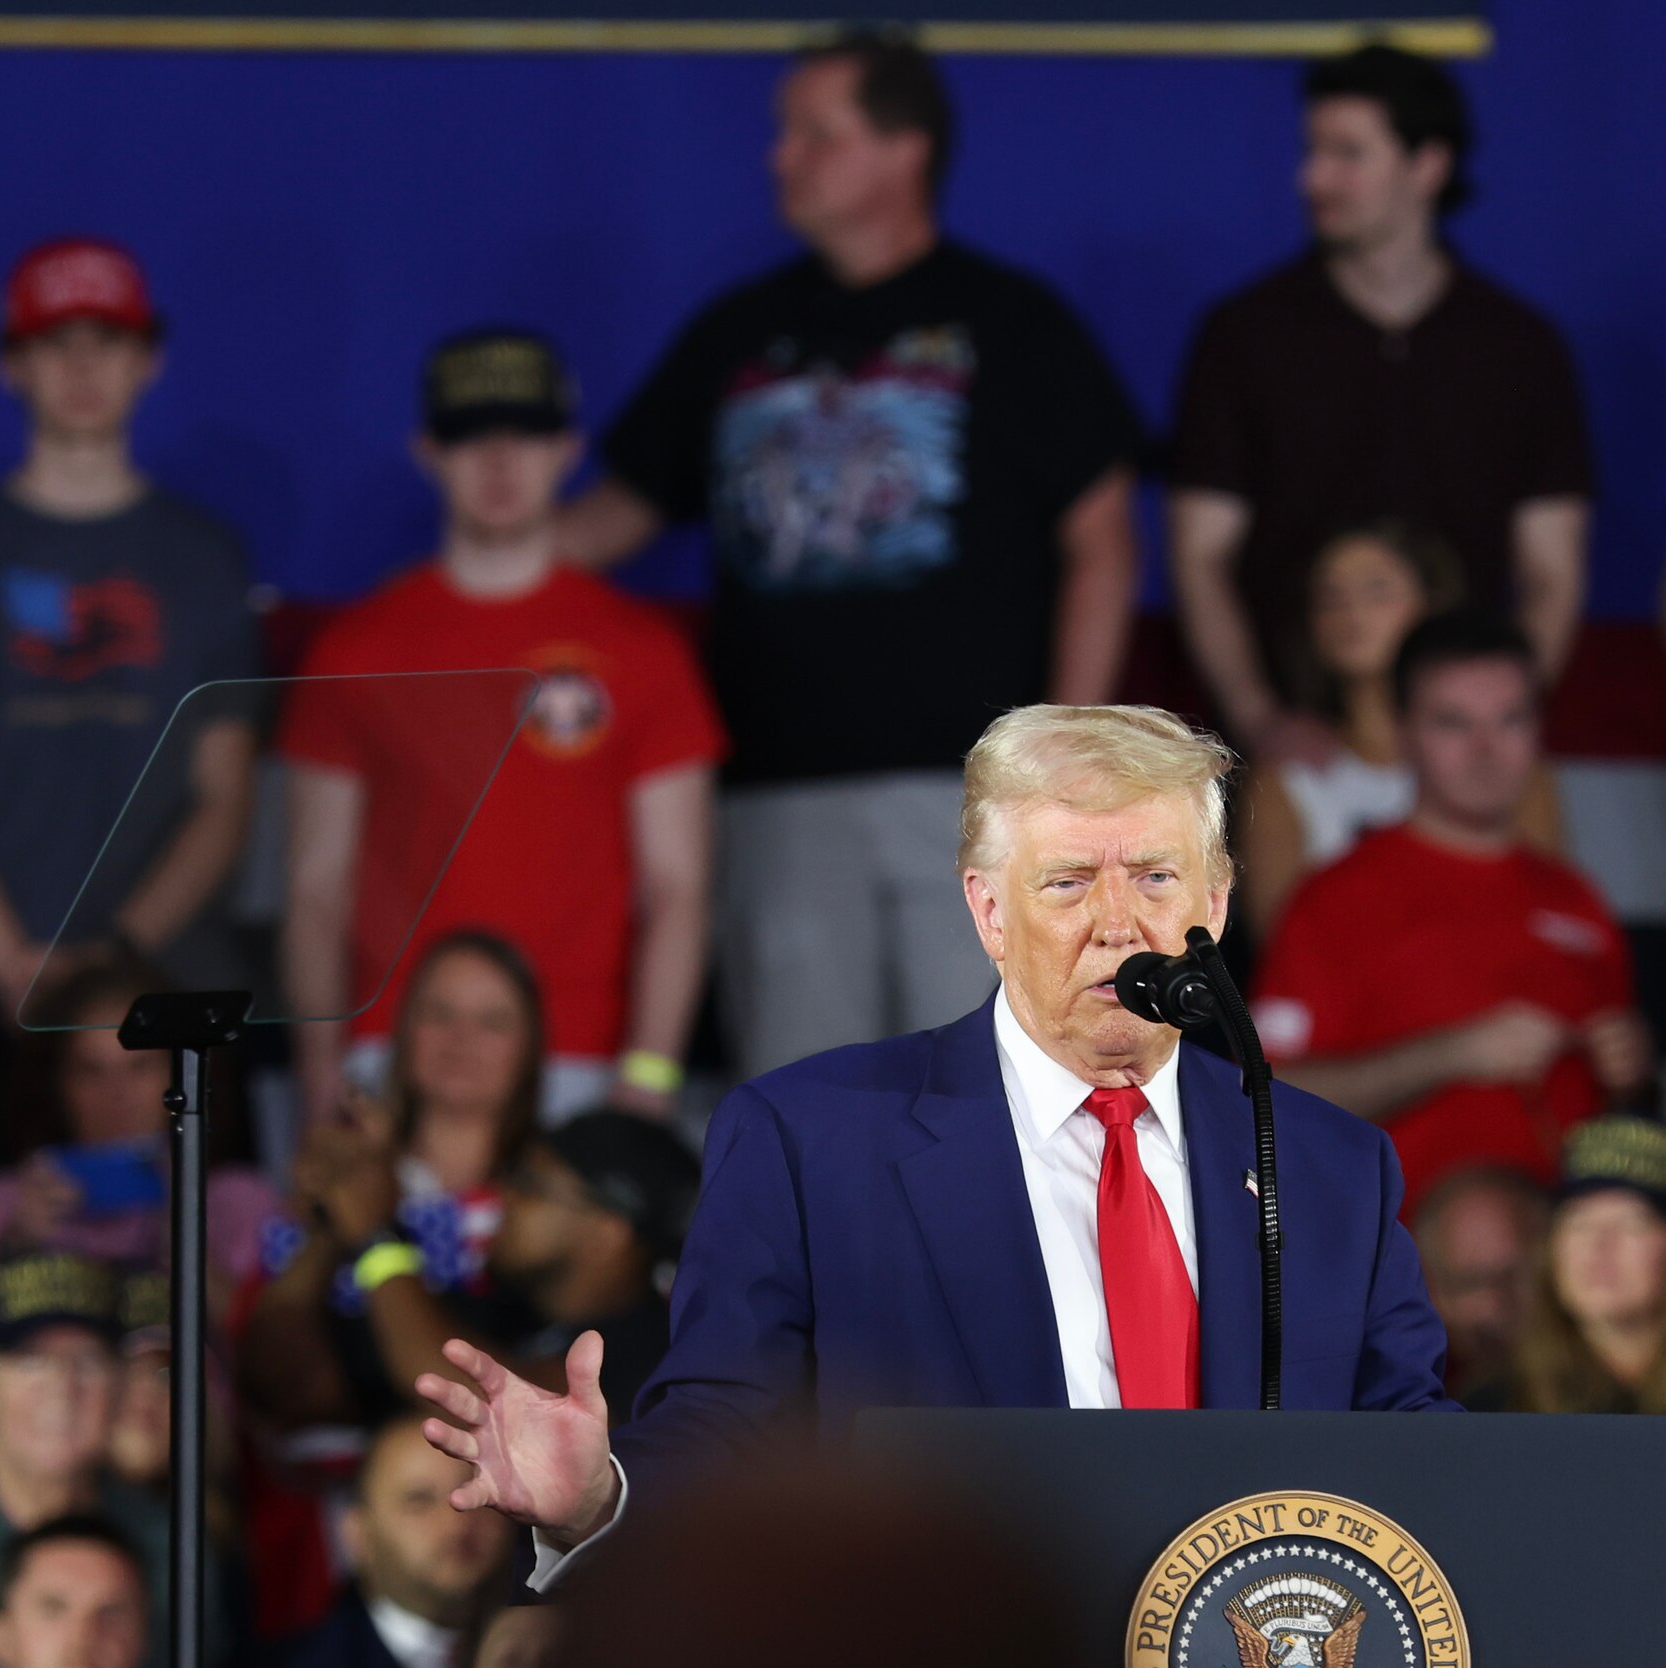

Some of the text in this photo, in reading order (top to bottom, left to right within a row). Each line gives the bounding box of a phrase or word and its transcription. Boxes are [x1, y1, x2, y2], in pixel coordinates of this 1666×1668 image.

[1136, 1503, 1287, 1654] PRESIDENT
[1297, 1507, 1330, 1529] OF
[1336, 1513, 1379, 1549] THE
[1270, 1619, 1307, 1629] PLURIBUS
[1307, 1623, 1331, 1632] UNUM
